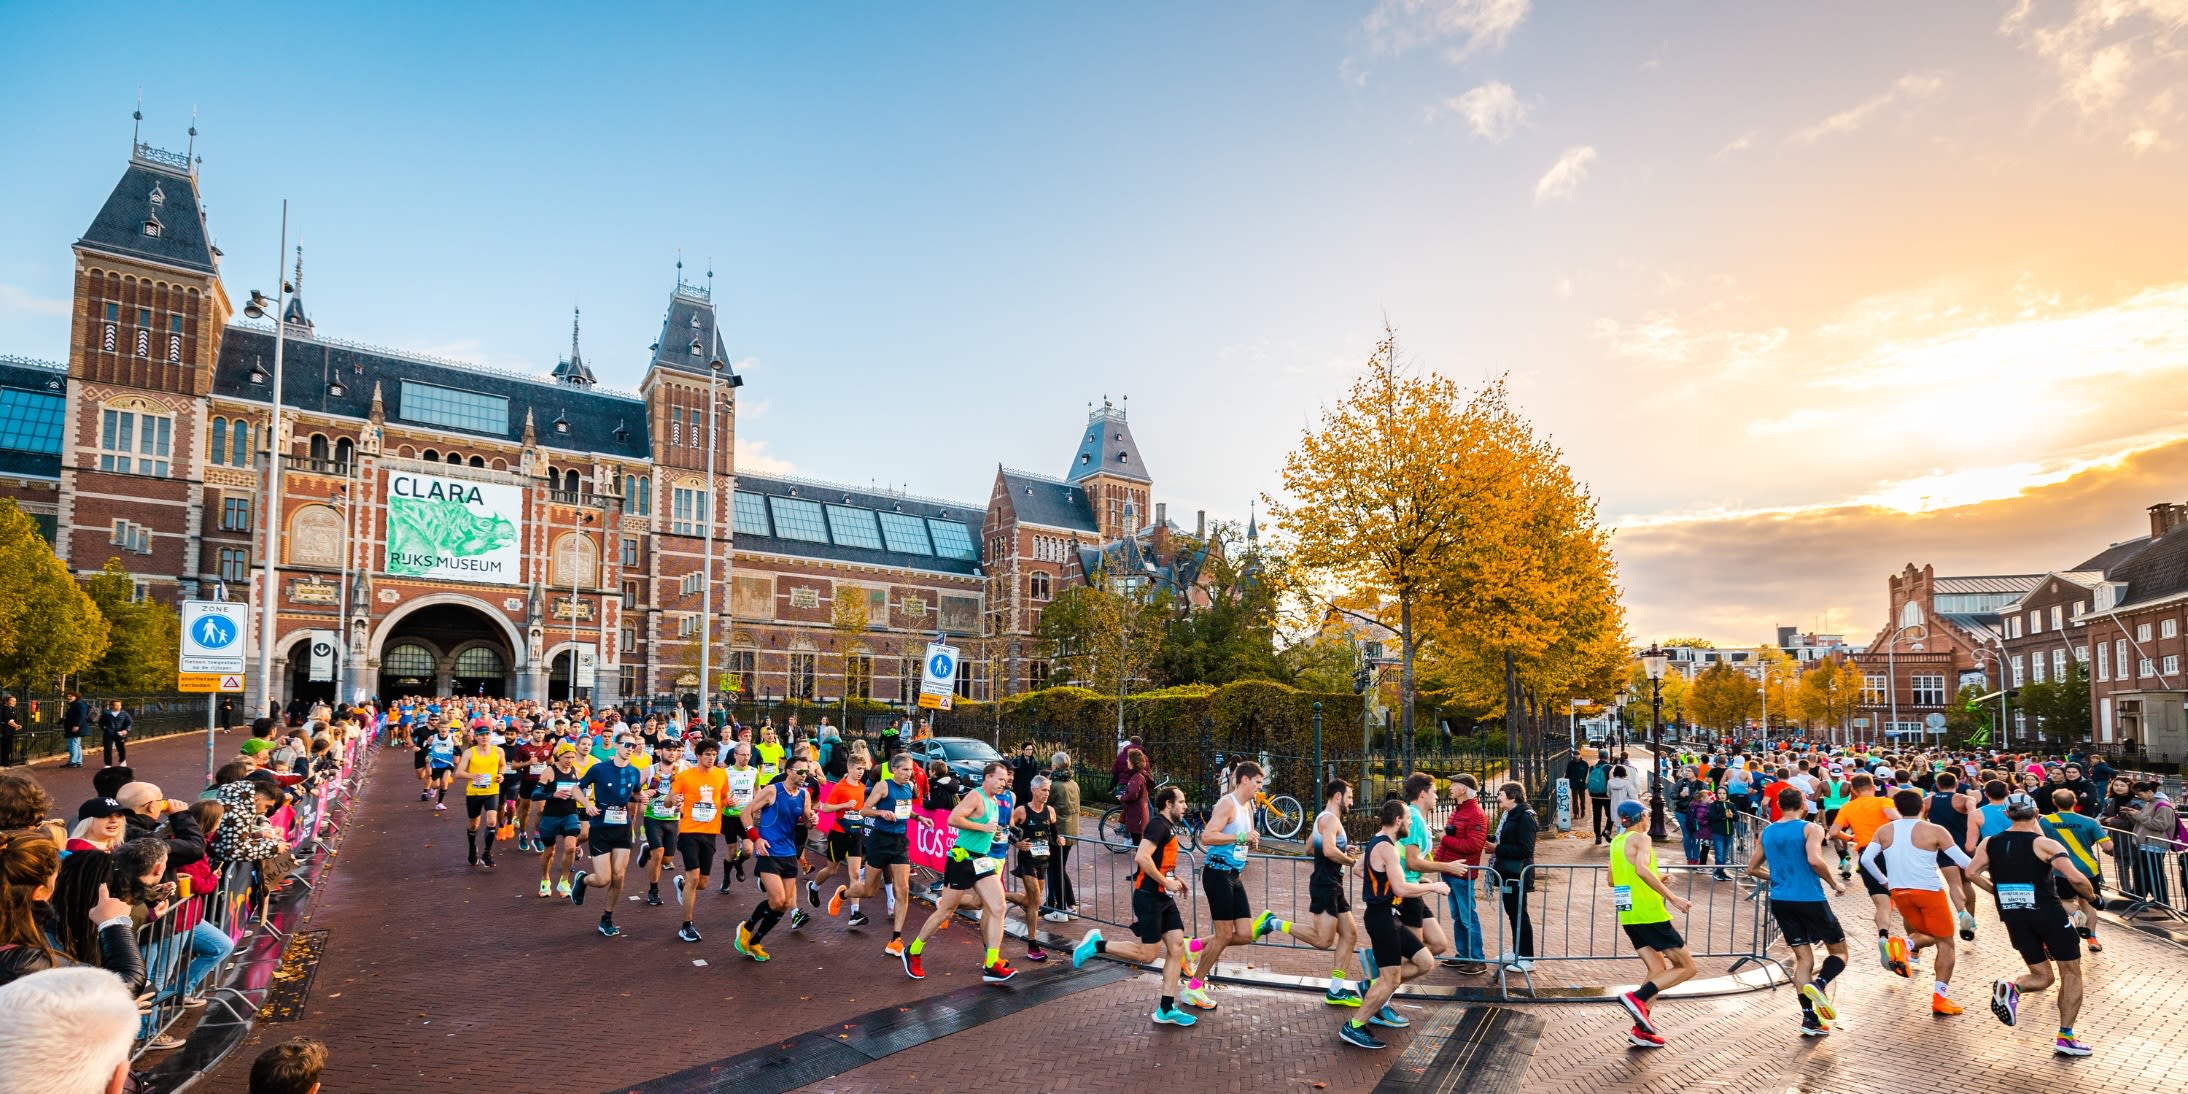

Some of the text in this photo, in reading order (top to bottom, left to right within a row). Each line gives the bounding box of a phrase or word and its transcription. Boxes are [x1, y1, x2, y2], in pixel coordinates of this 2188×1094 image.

[394, 476, 484, 506] CLARA
[436, 556, 503, 573] MUSEUM
[201, 605, 230, 613] ZONE
